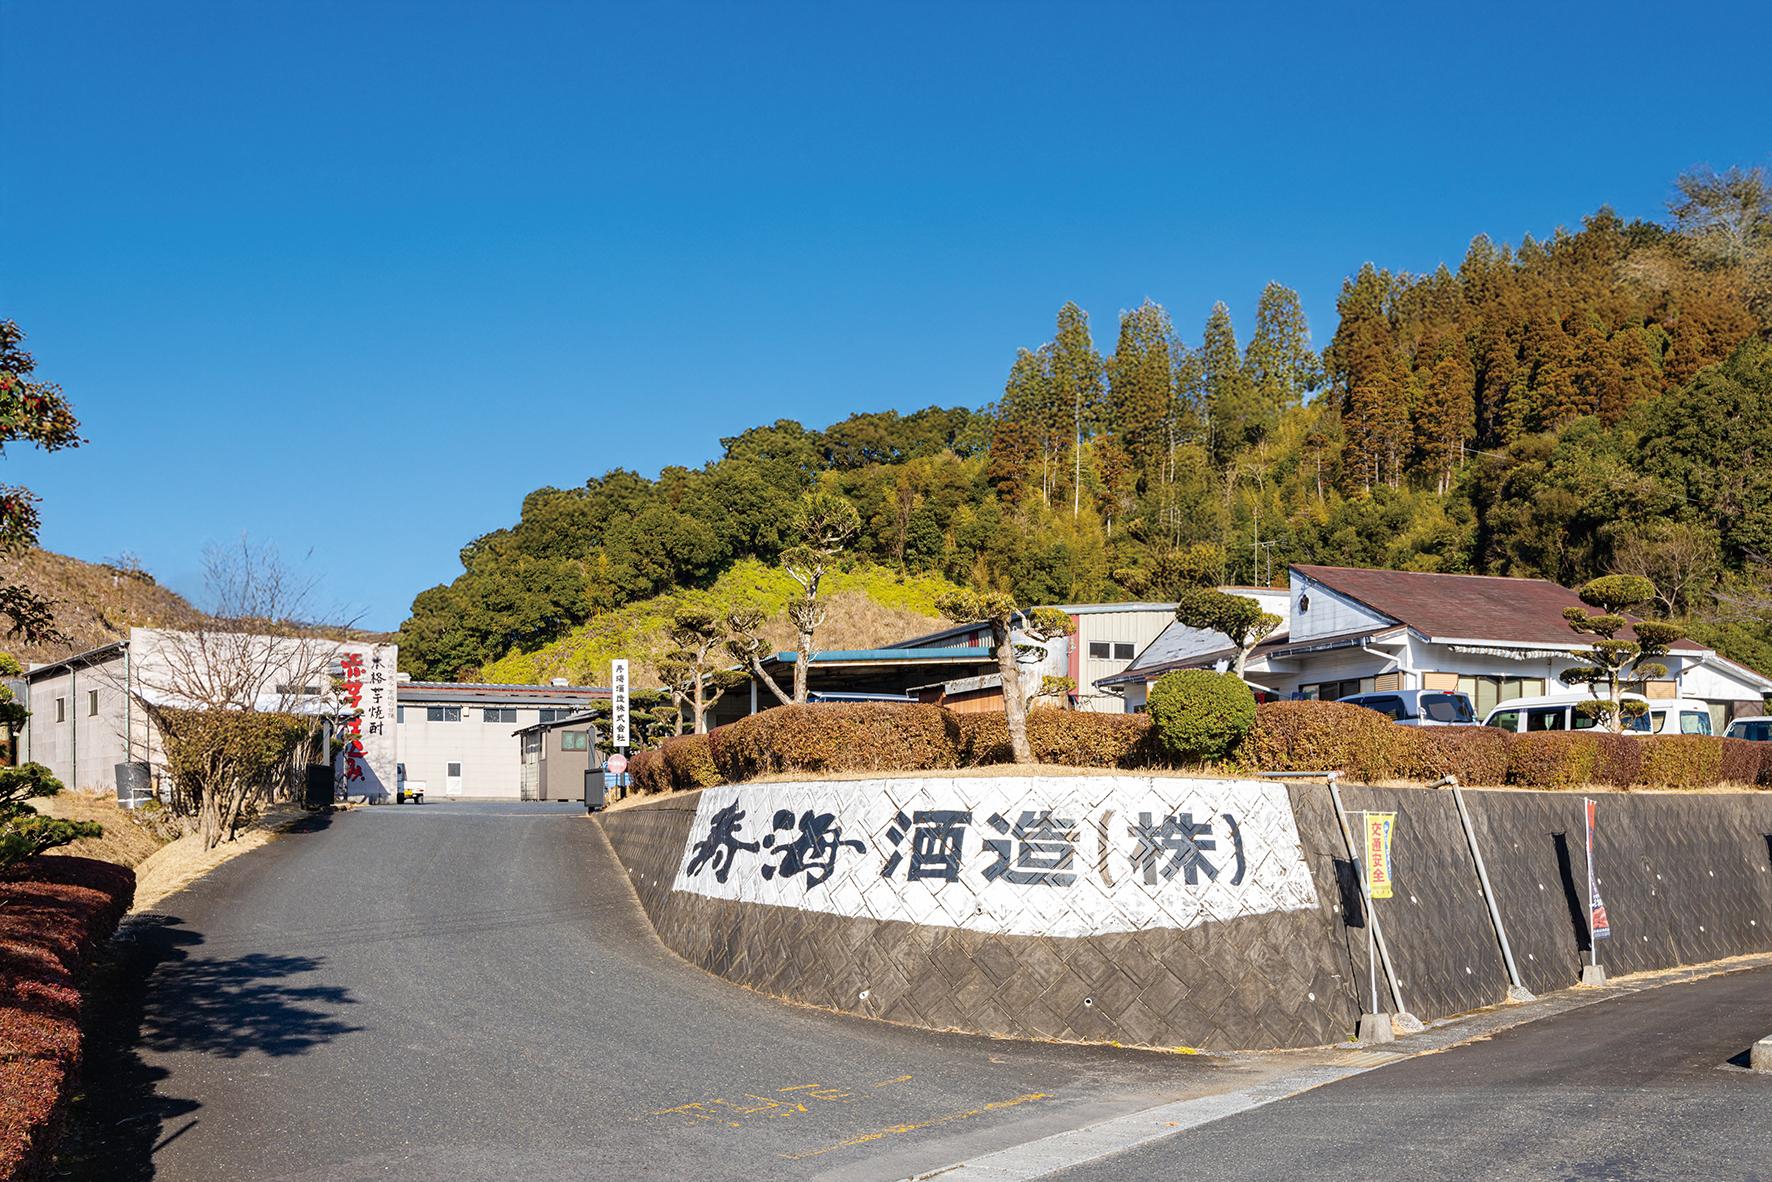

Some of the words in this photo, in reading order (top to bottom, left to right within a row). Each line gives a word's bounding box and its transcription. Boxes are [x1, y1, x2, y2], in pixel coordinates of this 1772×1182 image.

[369, 657, 386, 736] 本格芋焼酎
[1371, 822, 1385, 883] 交通安全
